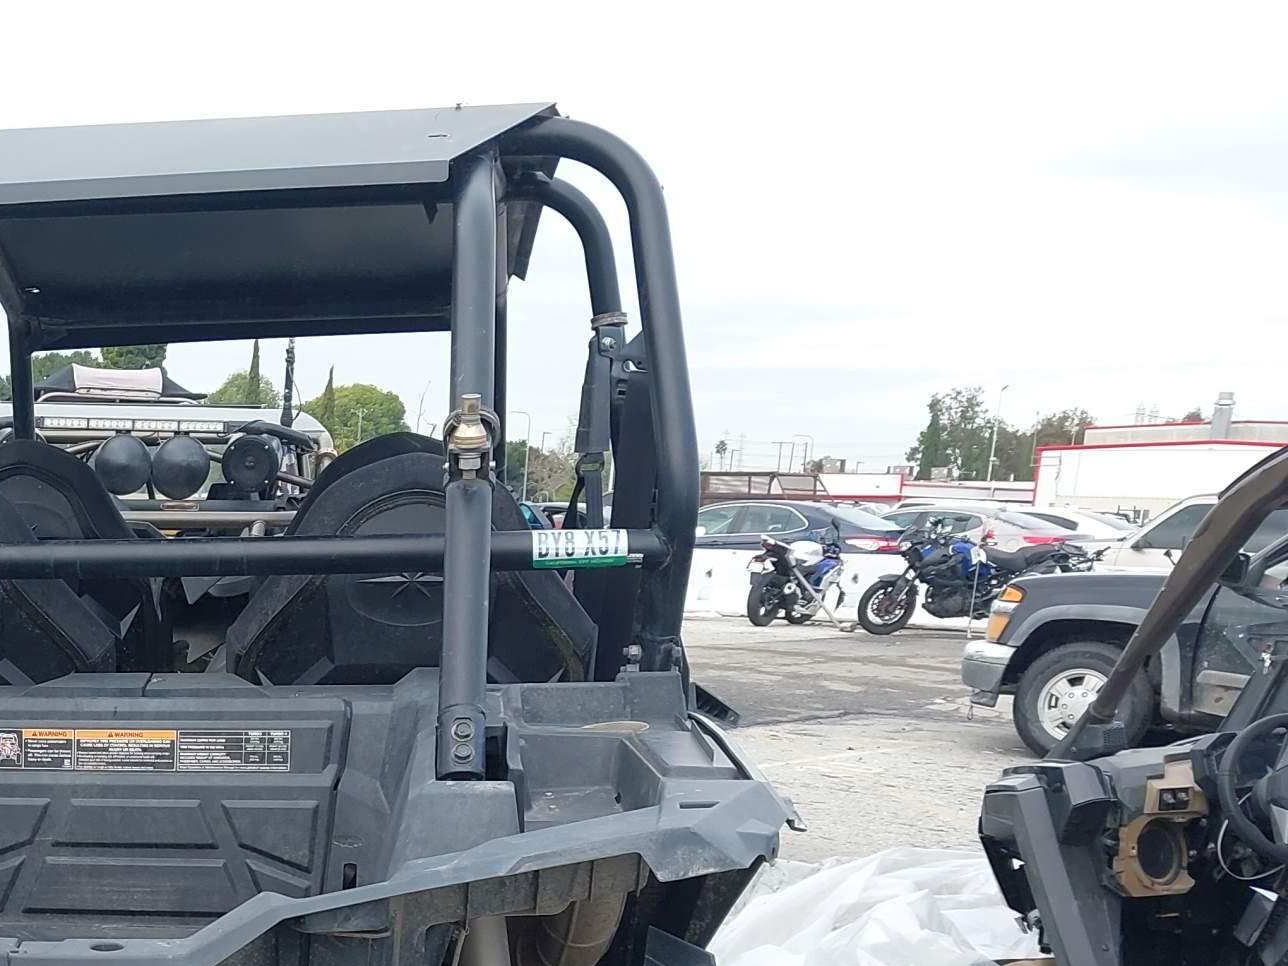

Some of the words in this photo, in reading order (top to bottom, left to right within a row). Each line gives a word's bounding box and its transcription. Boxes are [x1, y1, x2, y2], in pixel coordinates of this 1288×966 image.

[584, 530, 621, 556] X57
[38, 730, 68, 738] WARNING
[114, 731, 144, 739] WARNING
